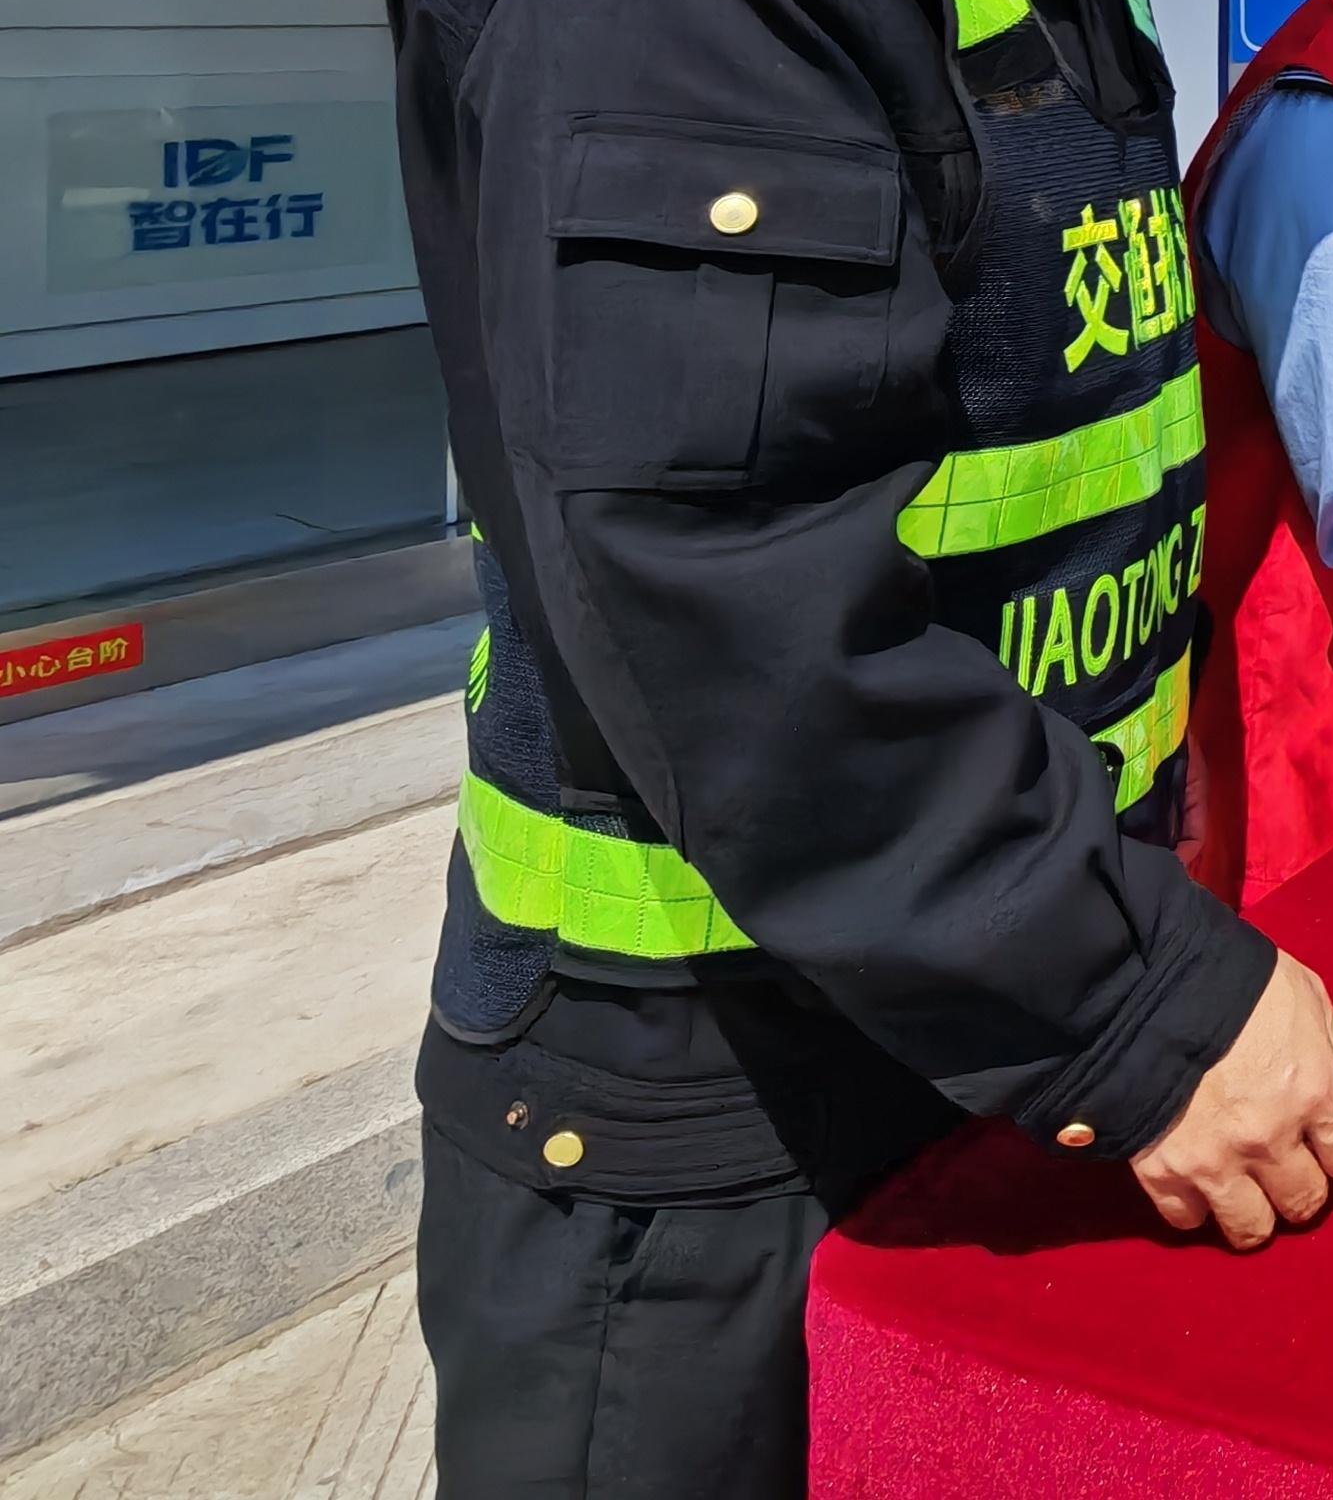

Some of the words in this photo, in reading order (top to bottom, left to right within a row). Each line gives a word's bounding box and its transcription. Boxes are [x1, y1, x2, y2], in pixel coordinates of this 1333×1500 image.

[164, 134, 294, 189] IDF
[130, 192, 324, 251] 智在行
[0, 637, 129, 687] 小心台阶
